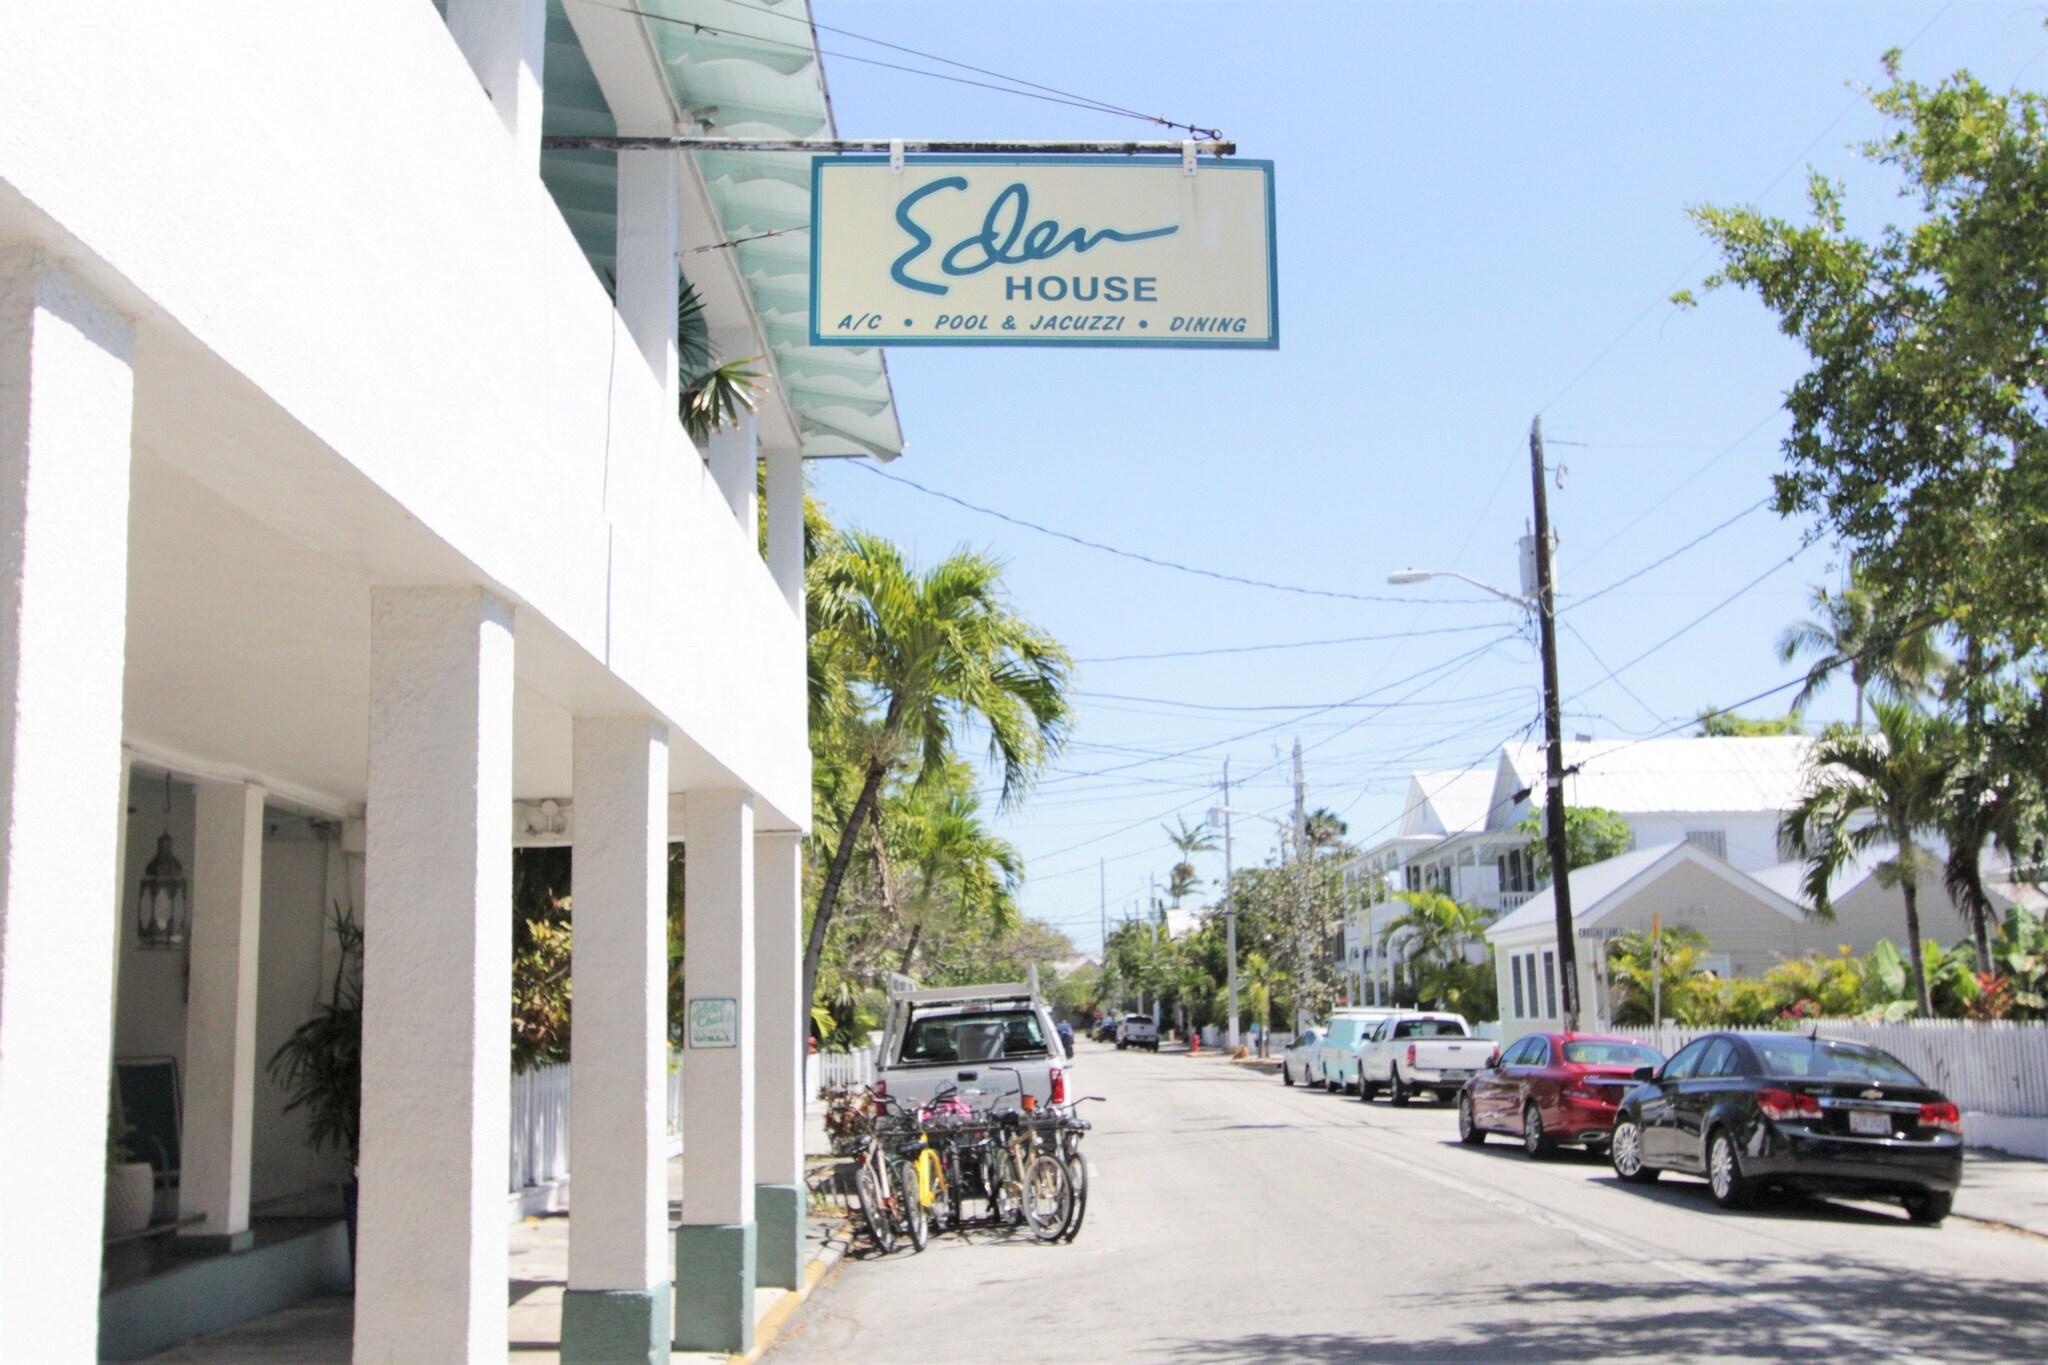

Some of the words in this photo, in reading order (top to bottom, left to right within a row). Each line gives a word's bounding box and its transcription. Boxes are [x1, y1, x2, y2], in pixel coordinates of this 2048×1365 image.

[890, 176, 1179, 296] Eden
[1005, 276, 1158, 302] HOUSE
[837, 313, 882, 330] A/C
[934, 314, 989, 330] POOL
[1001, 315, 1017, 331] &
[1029, 314, 1126, 332] JACUZZI
[1168, 316, 1247, 333] DINING
